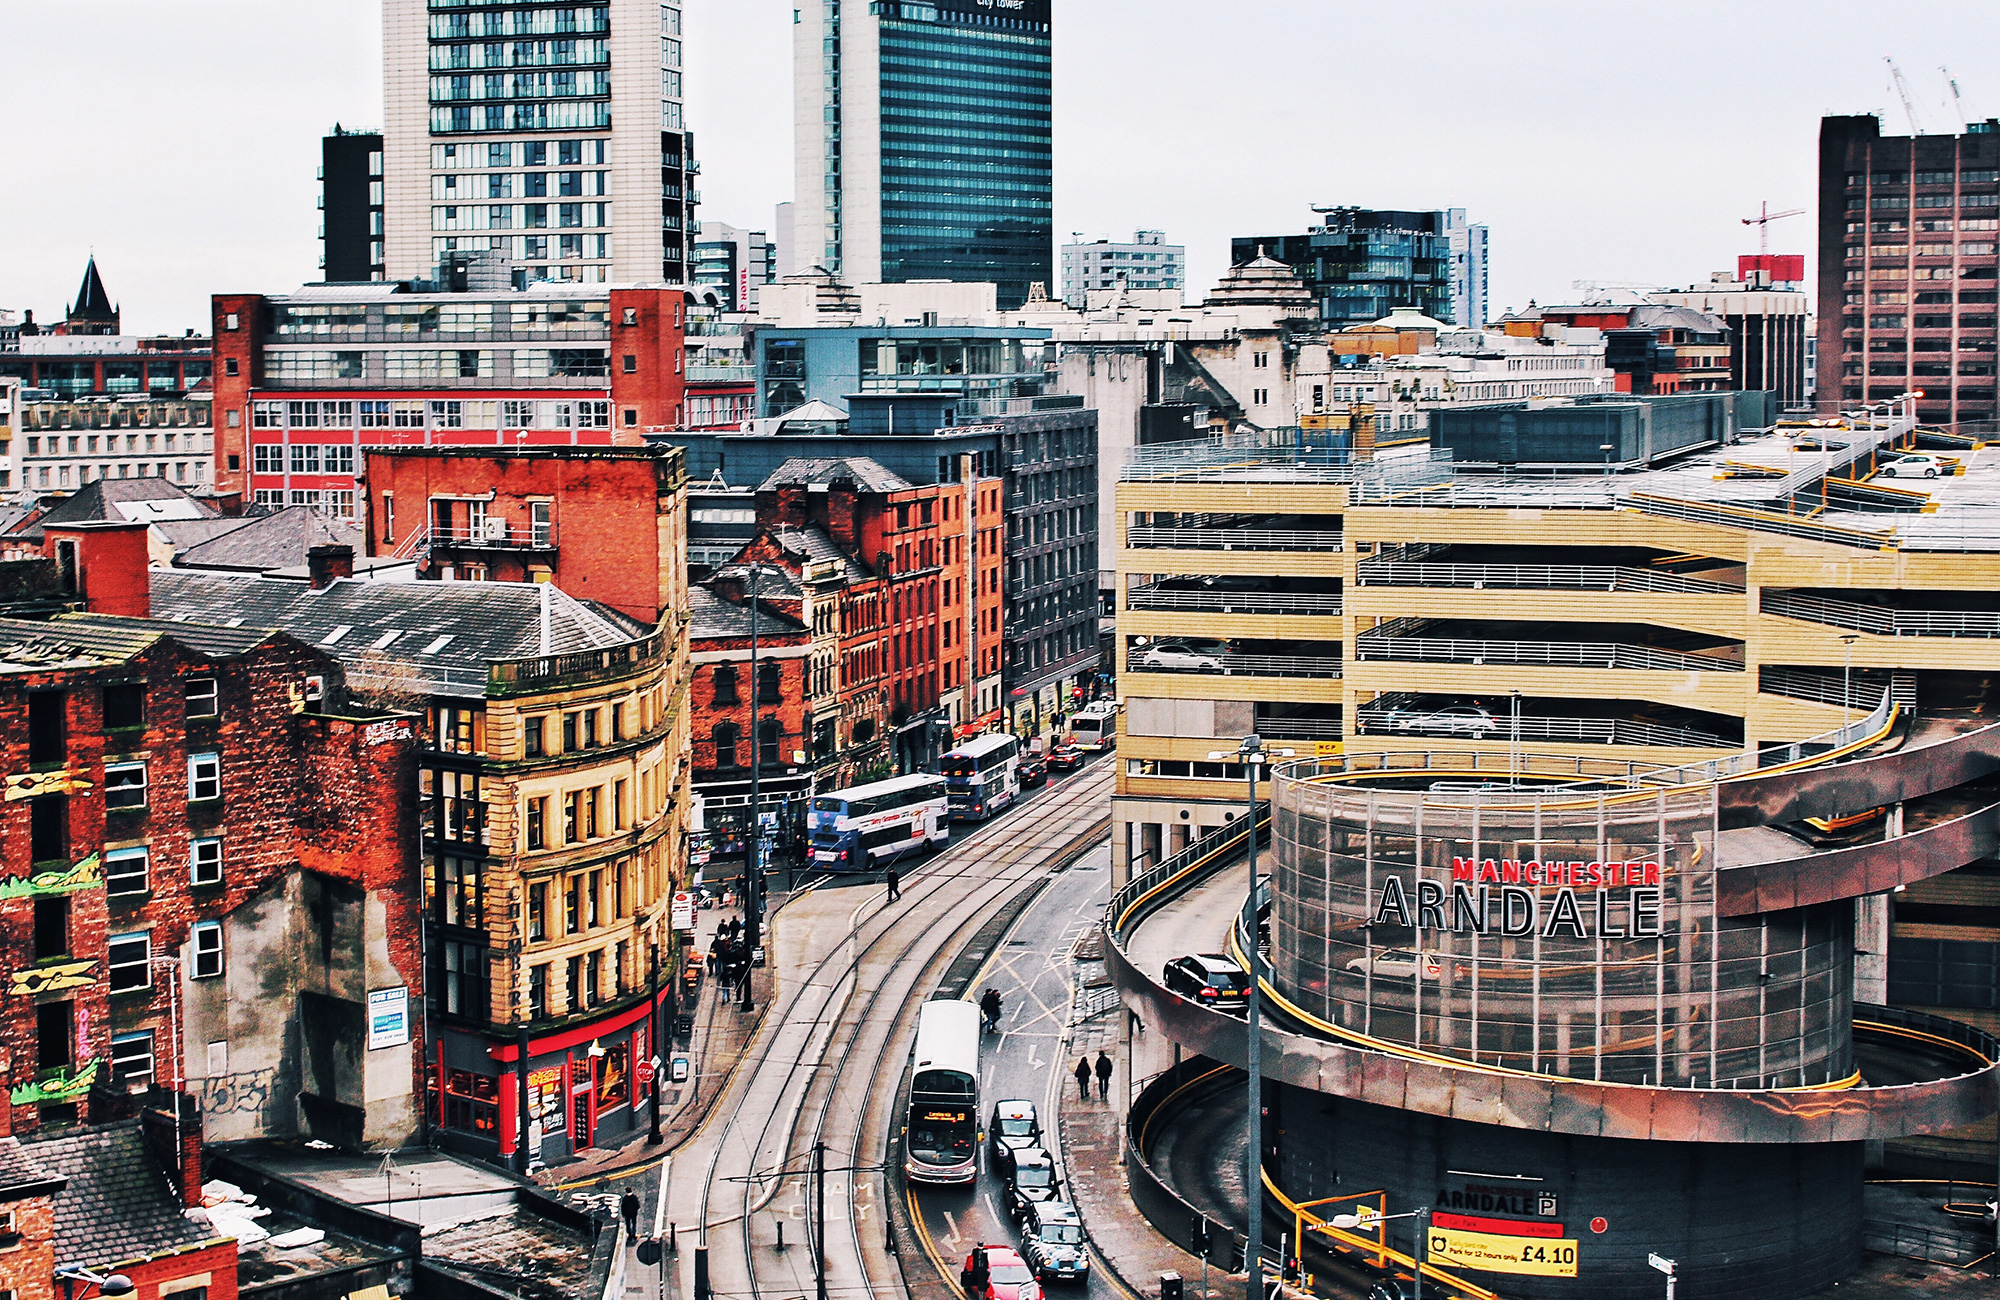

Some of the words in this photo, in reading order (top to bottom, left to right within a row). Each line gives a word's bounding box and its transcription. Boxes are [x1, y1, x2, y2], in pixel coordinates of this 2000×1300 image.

[1453, 856, 1660, 886] MANCHESTER
[1374, 874, 1660, 938] ARNDALE
[507, 886, 521, 1021] CHAMBERS
[371, 993, 386, 1003] FOR
[387, 989, 404, 1000] SALE
[638, 1068, 653, 1079] STOP
[1435, 1189, 1534, 1216] ARNDALE
[1541, 1199, 1554, 1214] P
[1449, 1247, 1463, 1255] Park
[1484, 1252, 1502, 1260] hours
[1503, 1254, 1518, 1263] only
[1520, 1245, 1575, 1264] £4.10
